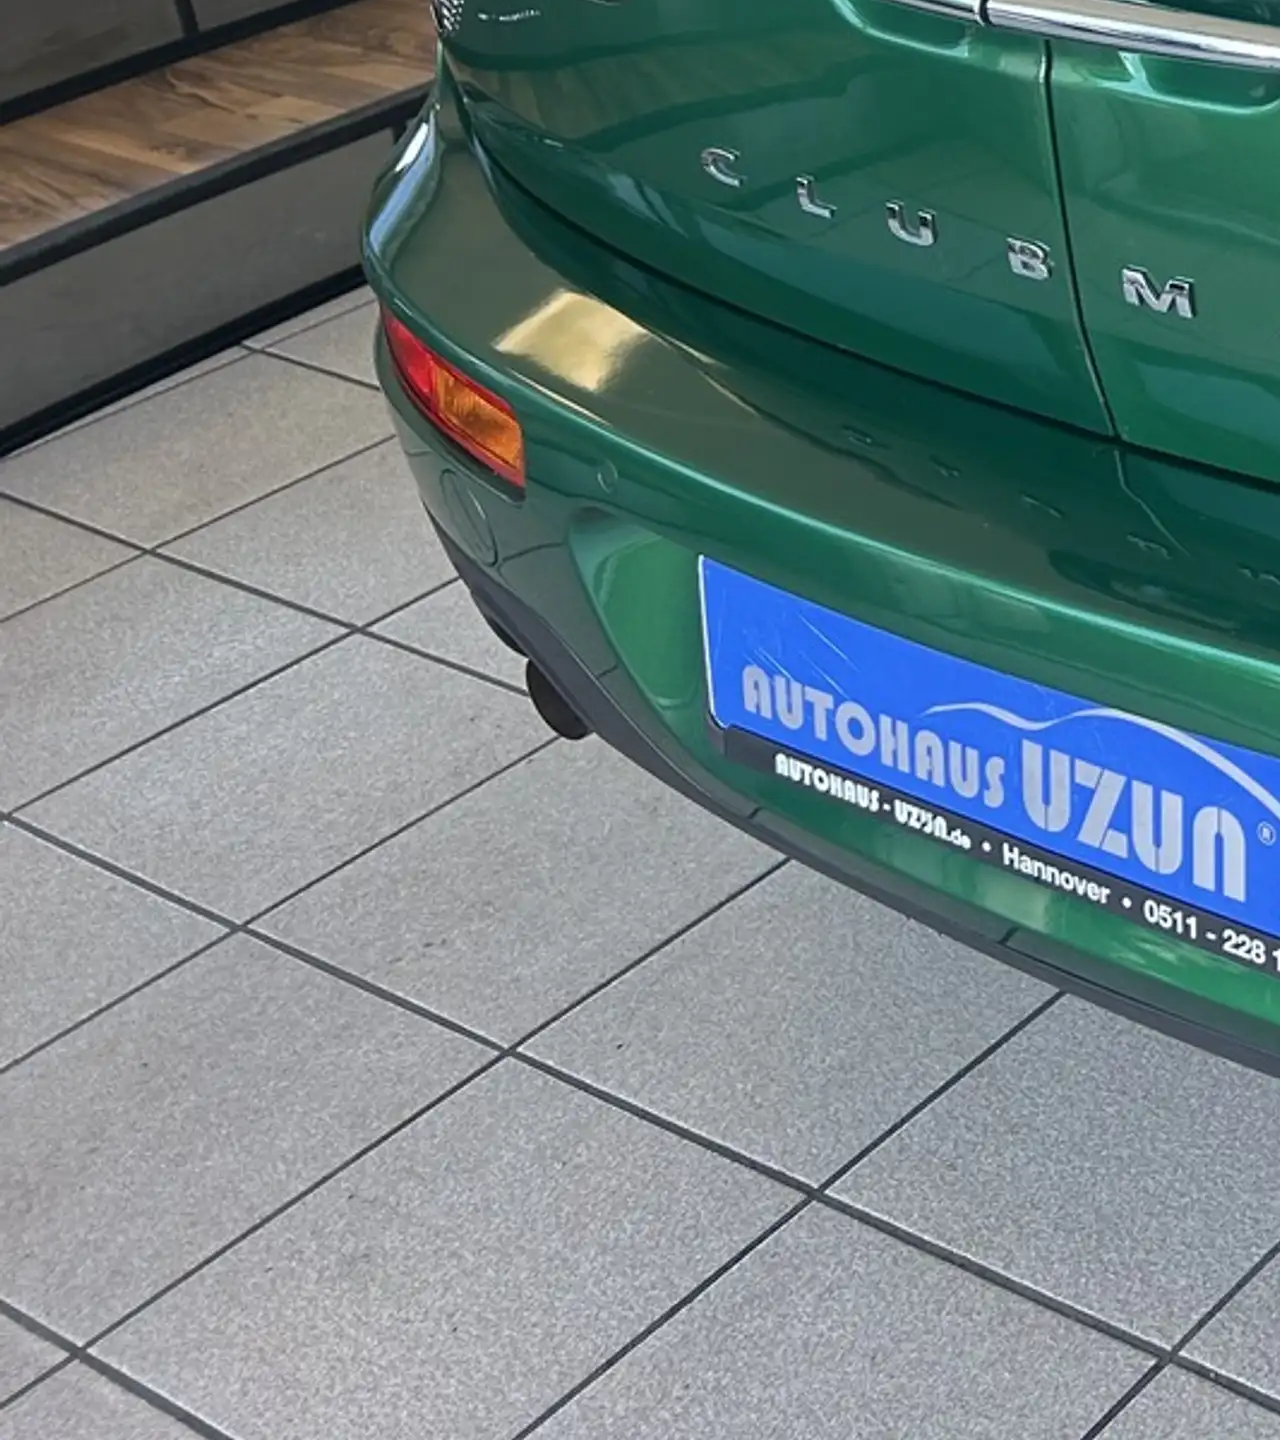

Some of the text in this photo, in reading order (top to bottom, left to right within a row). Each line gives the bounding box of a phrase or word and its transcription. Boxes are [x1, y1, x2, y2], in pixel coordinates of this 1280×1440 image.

[742, 664, 1247, 903] AUTOHAUS UZUN
[774, 752, 880, 813] AUTOHAUS
[1003, 842, 1110, 904] Hannover
[1143, 899, 1197, 940] 0511
[1222, 928, 1266, 965] 228
